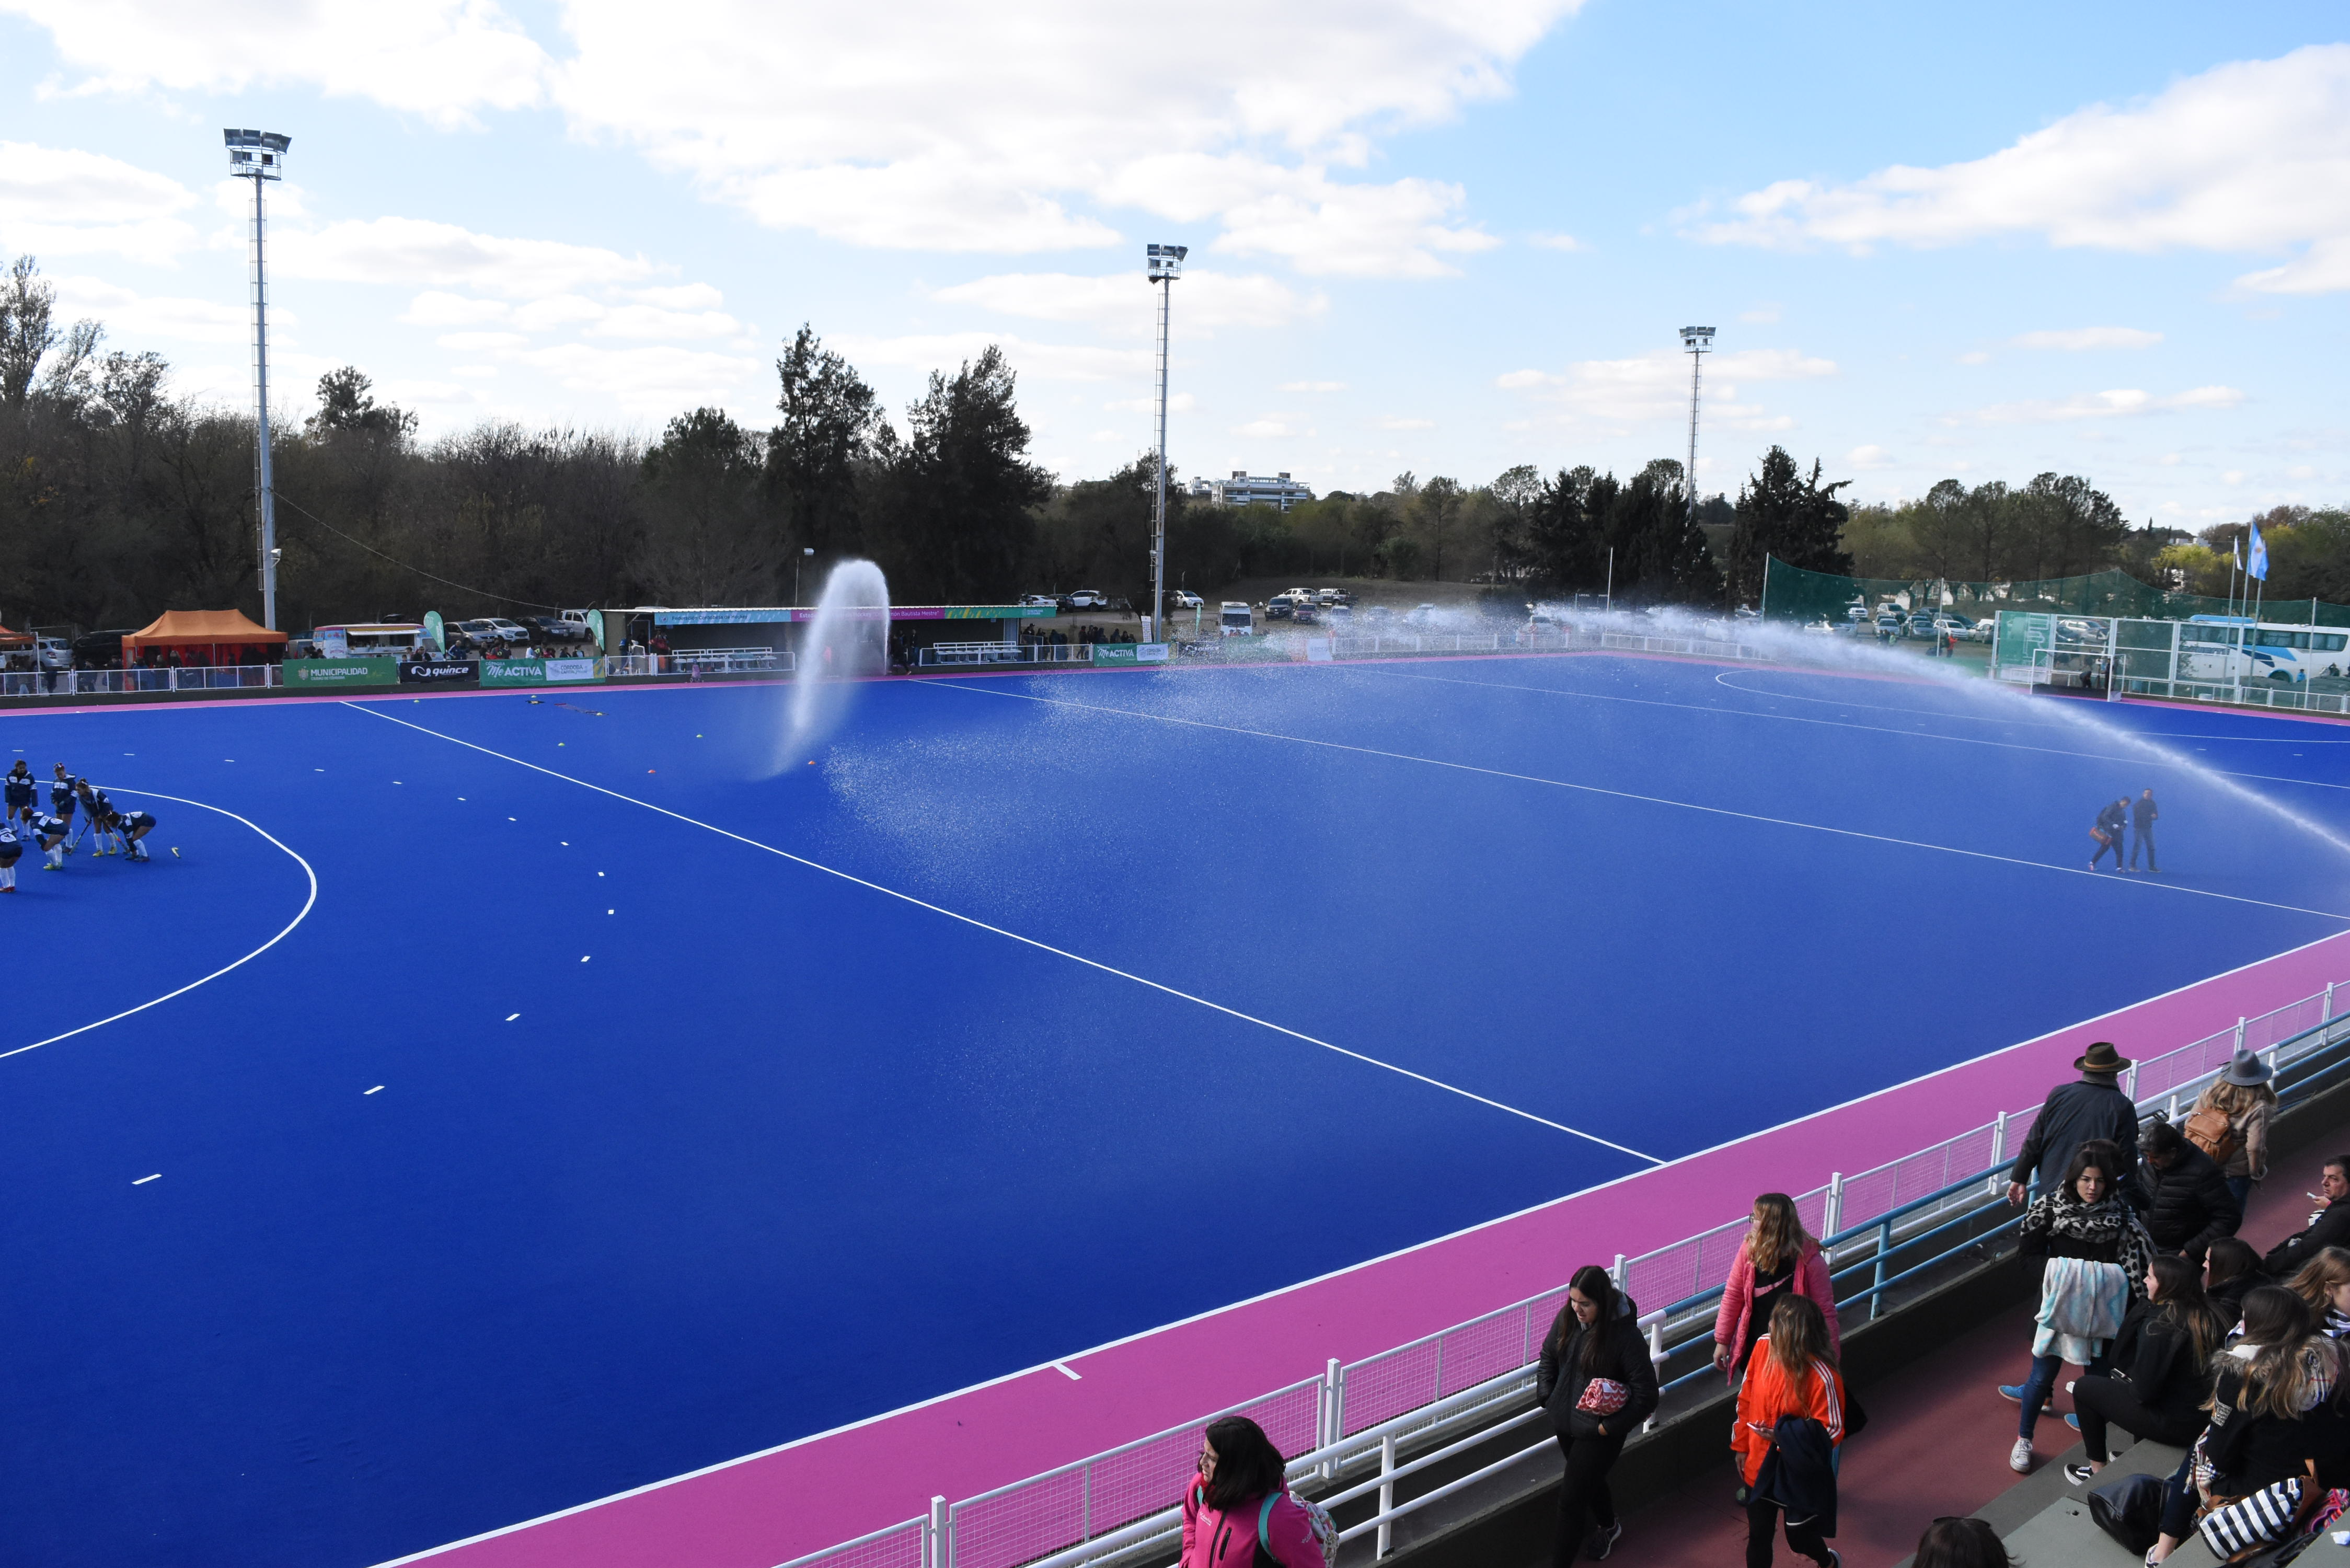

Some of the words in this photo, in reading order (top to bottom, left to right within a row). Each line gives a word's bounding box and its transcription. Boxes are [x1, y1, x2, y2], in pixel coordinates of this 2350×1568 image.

[311, 667, 367, 676] MUNICIPALIDAD
[432, 665, 469, 677] quince
[487, 665, 504, 677] Me
[504, 667, 542, 676] ACTIVA
